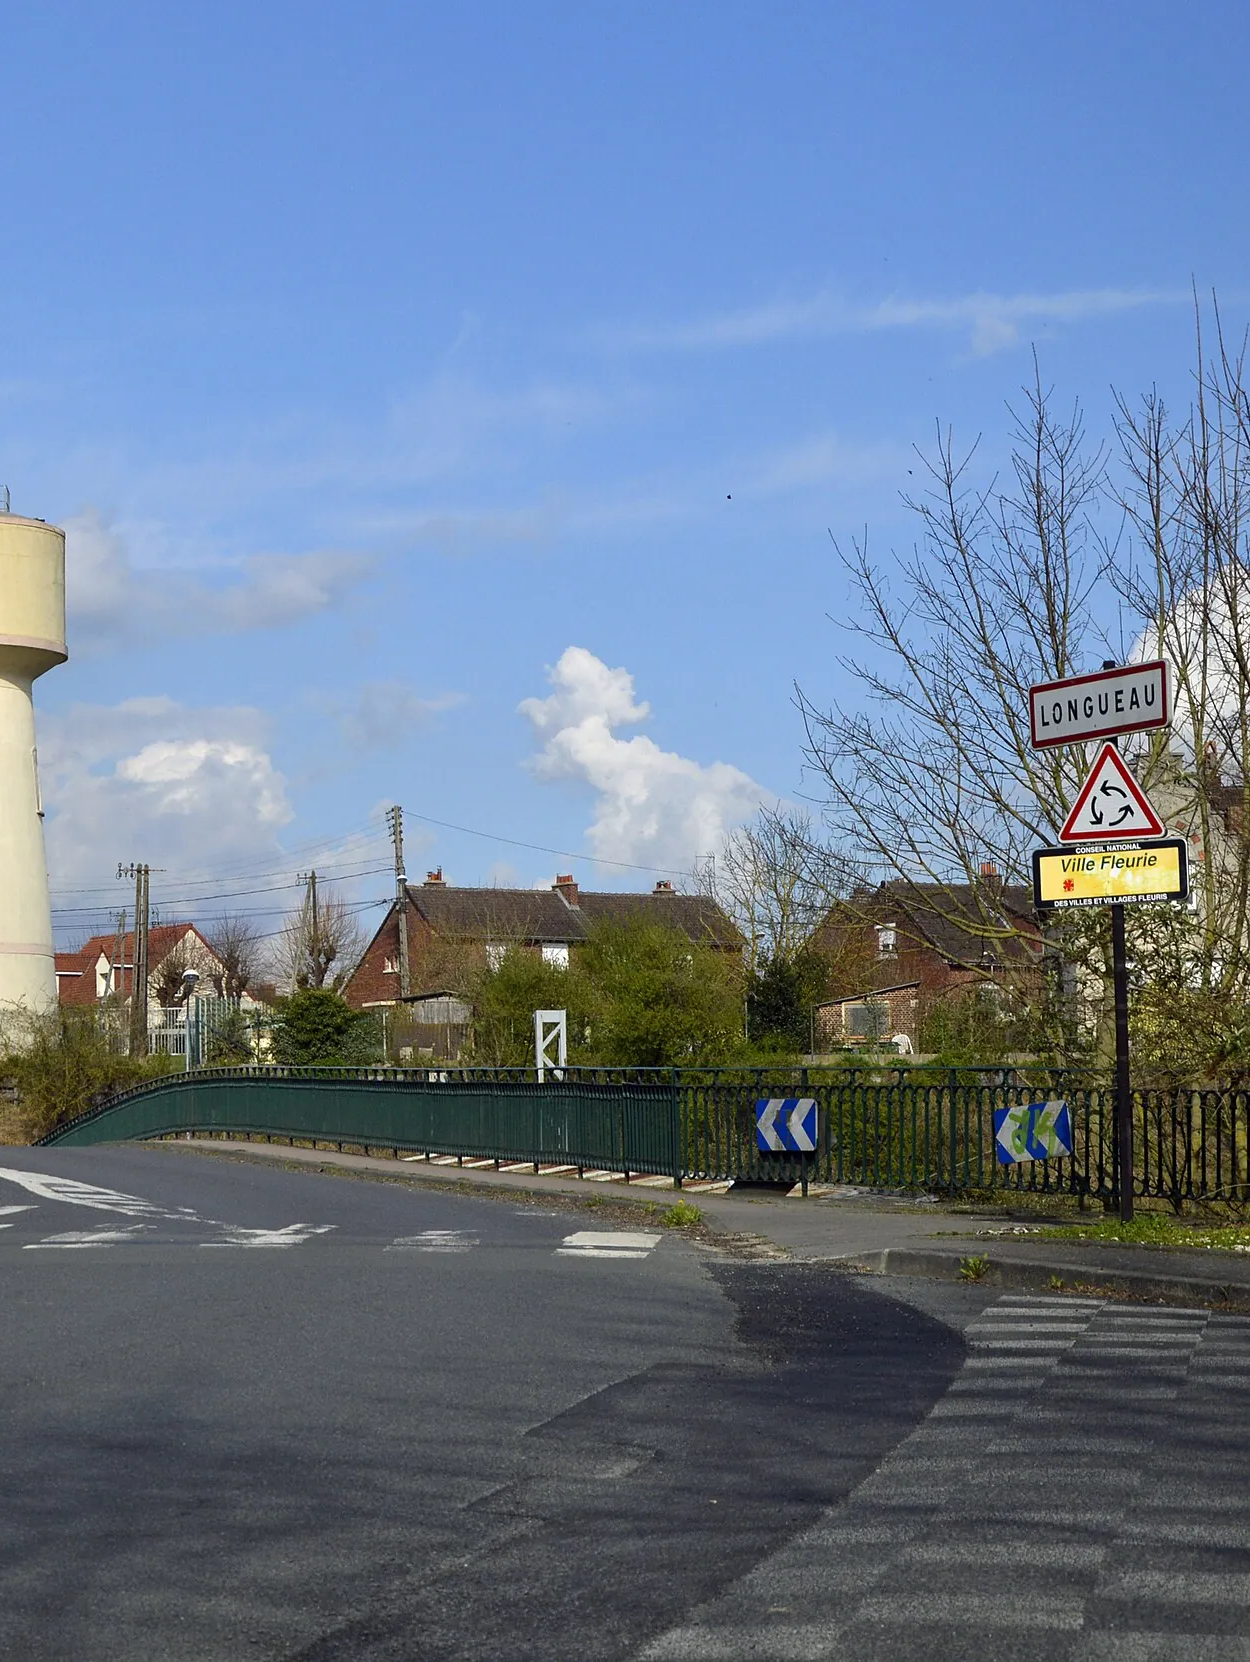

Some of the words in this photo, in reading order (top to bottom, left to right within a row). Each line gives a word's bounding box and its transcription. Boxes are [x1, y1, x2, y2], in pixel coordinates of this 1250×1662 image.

[1041, 684, 1155, 727] LONGUEAU
[1075, 846, 1105, 854] CONSEIL
[1106, 843, 1141, 852] NATIONAL
[1061, 857, 1095, 873] Ville
[1100, 853, 1157, 870] Fleurie
[1069, 898, 1093, 906] VILLES
[1094, 897, 1103, 905] ET
[1103, 895, 1137, 904] VILLAGES
[1138, 893, 1168, 901] FLEURIS
